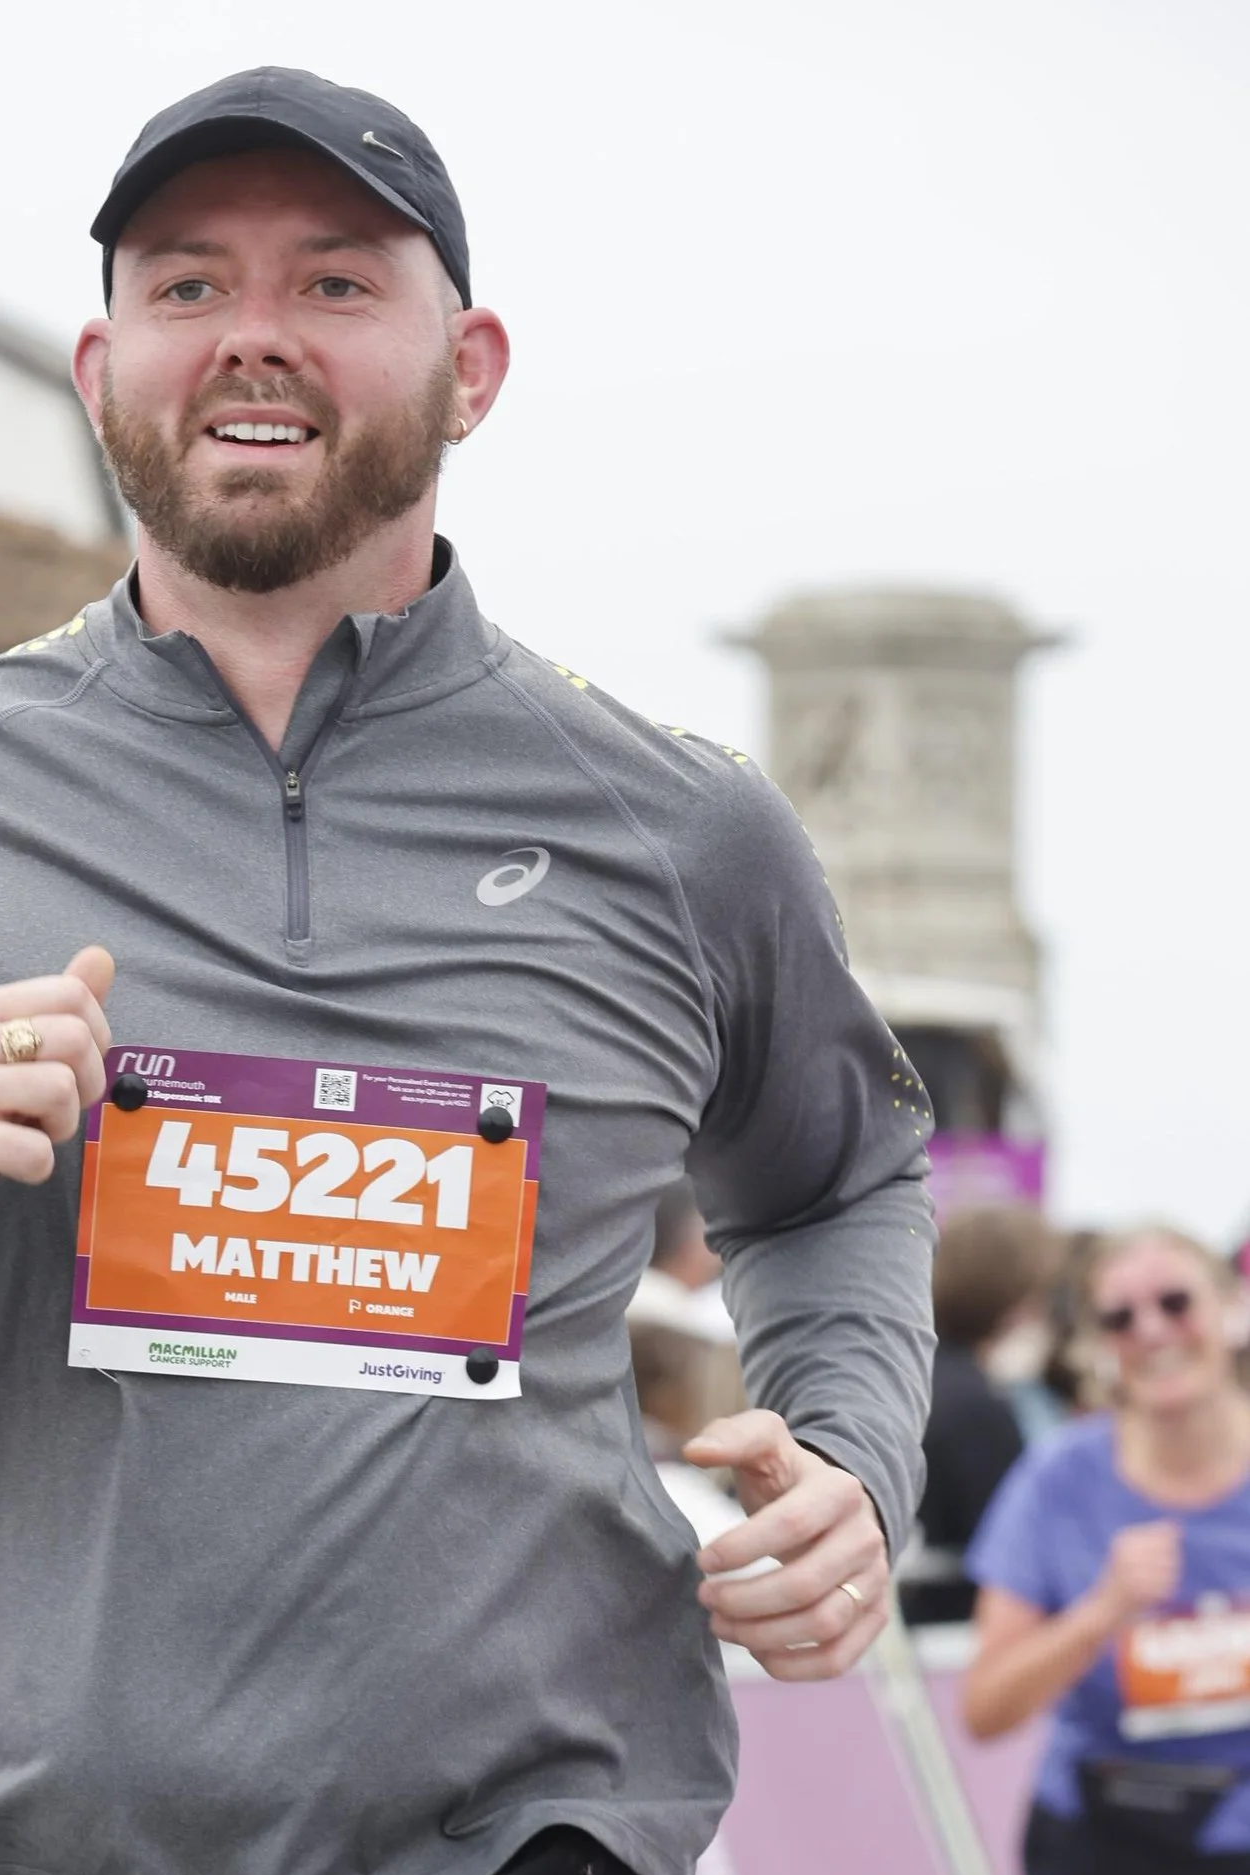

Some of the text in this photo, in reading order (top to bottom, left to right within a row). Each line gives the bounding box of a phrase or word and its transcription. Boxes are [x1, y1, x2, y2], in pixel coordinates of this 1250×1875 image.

[116, 1051, 176, 1077] run
[141, 1078, 206, 1091] urnemouth
[145, 1120, 475, 1231] 45221
[170, 1232, 441, 1294] MATTHEW
[224, 1291, 415, 1318] MALE ORANGE
[148, 1341, 238, 1361] MACMILLAN
[149, 1353, 233, 1369] CANCER SUPPORT
[358, 1361, 443, 1385] JustGiving
